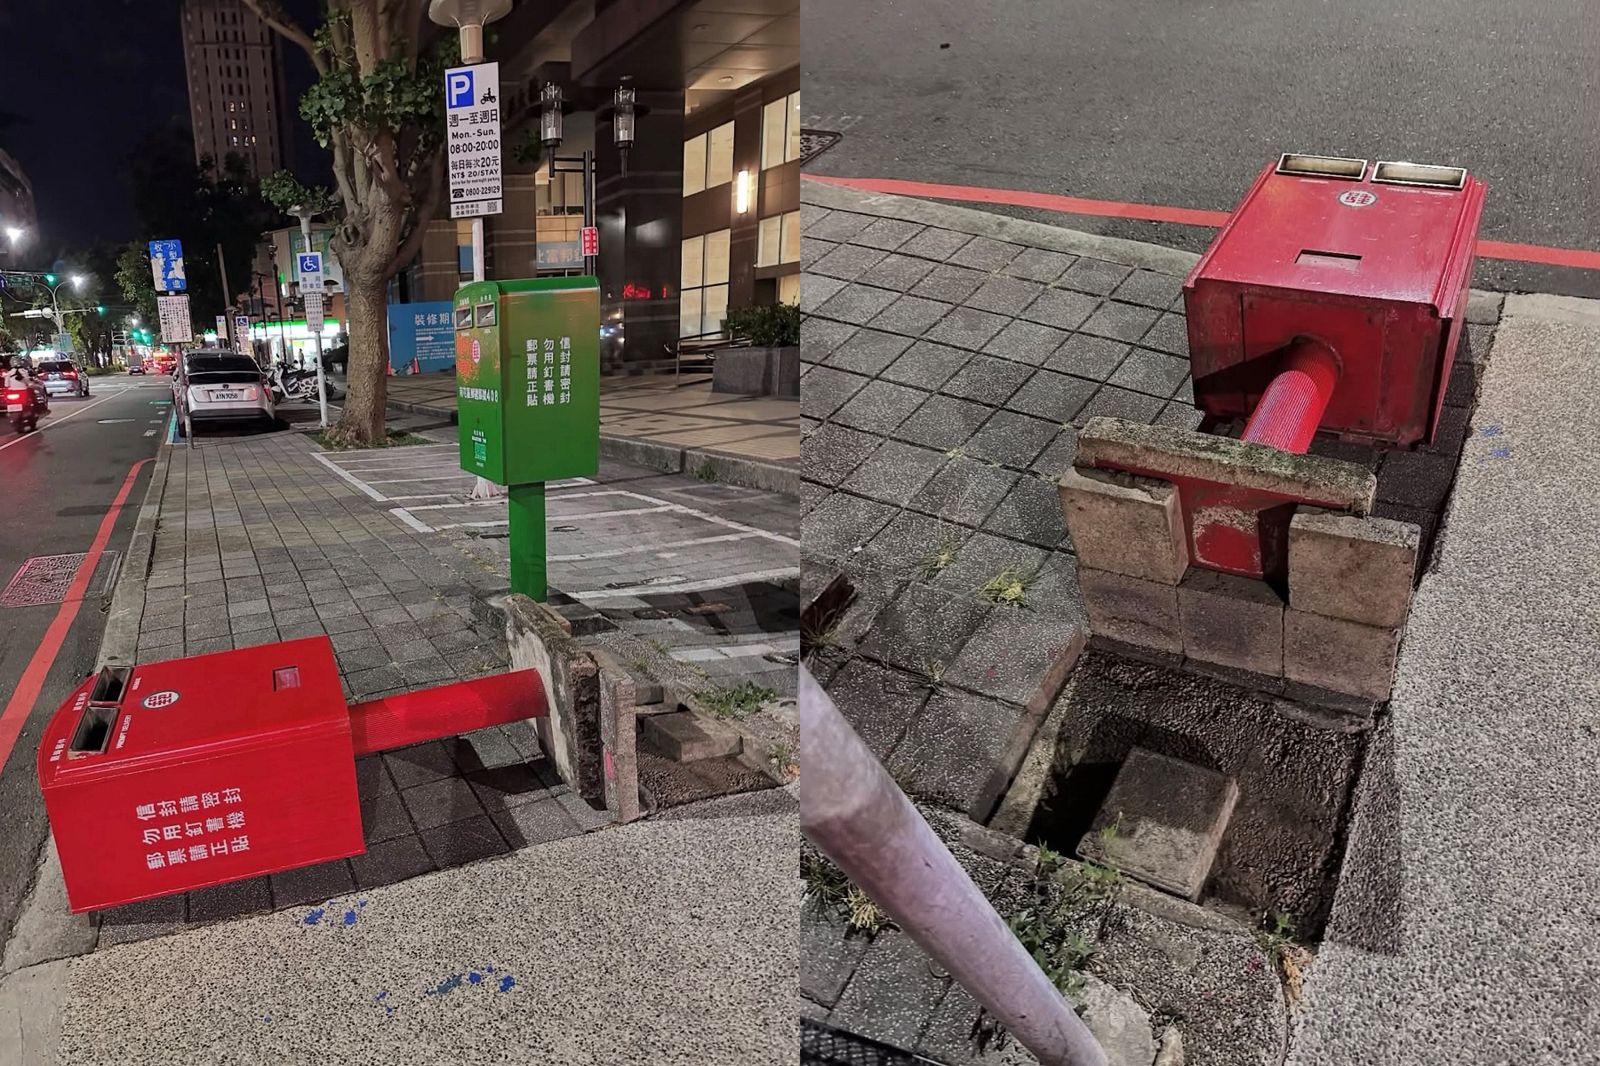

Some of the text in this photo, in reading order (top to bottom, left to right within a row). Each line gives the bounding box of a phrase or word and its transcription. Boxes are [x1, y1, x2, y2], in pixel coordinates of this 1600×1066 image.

[449, 109, 498, 128] 週一至週日
[451, 128, 496, 140] Mon.-Sun.
[451, 155, 499, 171] 每日每次20元
[451, 169, 499, 179] NT$ 20/STAY
[526, 339, 538, 407] 郵票請正貼
[543, 338, 555, 406] 勿用釘書機
[560, 336, 571, 404] 信封請密封
[135, 787, 242, 821] 信封請密封
[142, 810, 246, 845] 勿用釘書機
[146, 834, 251, 870] 郵票請正貼
